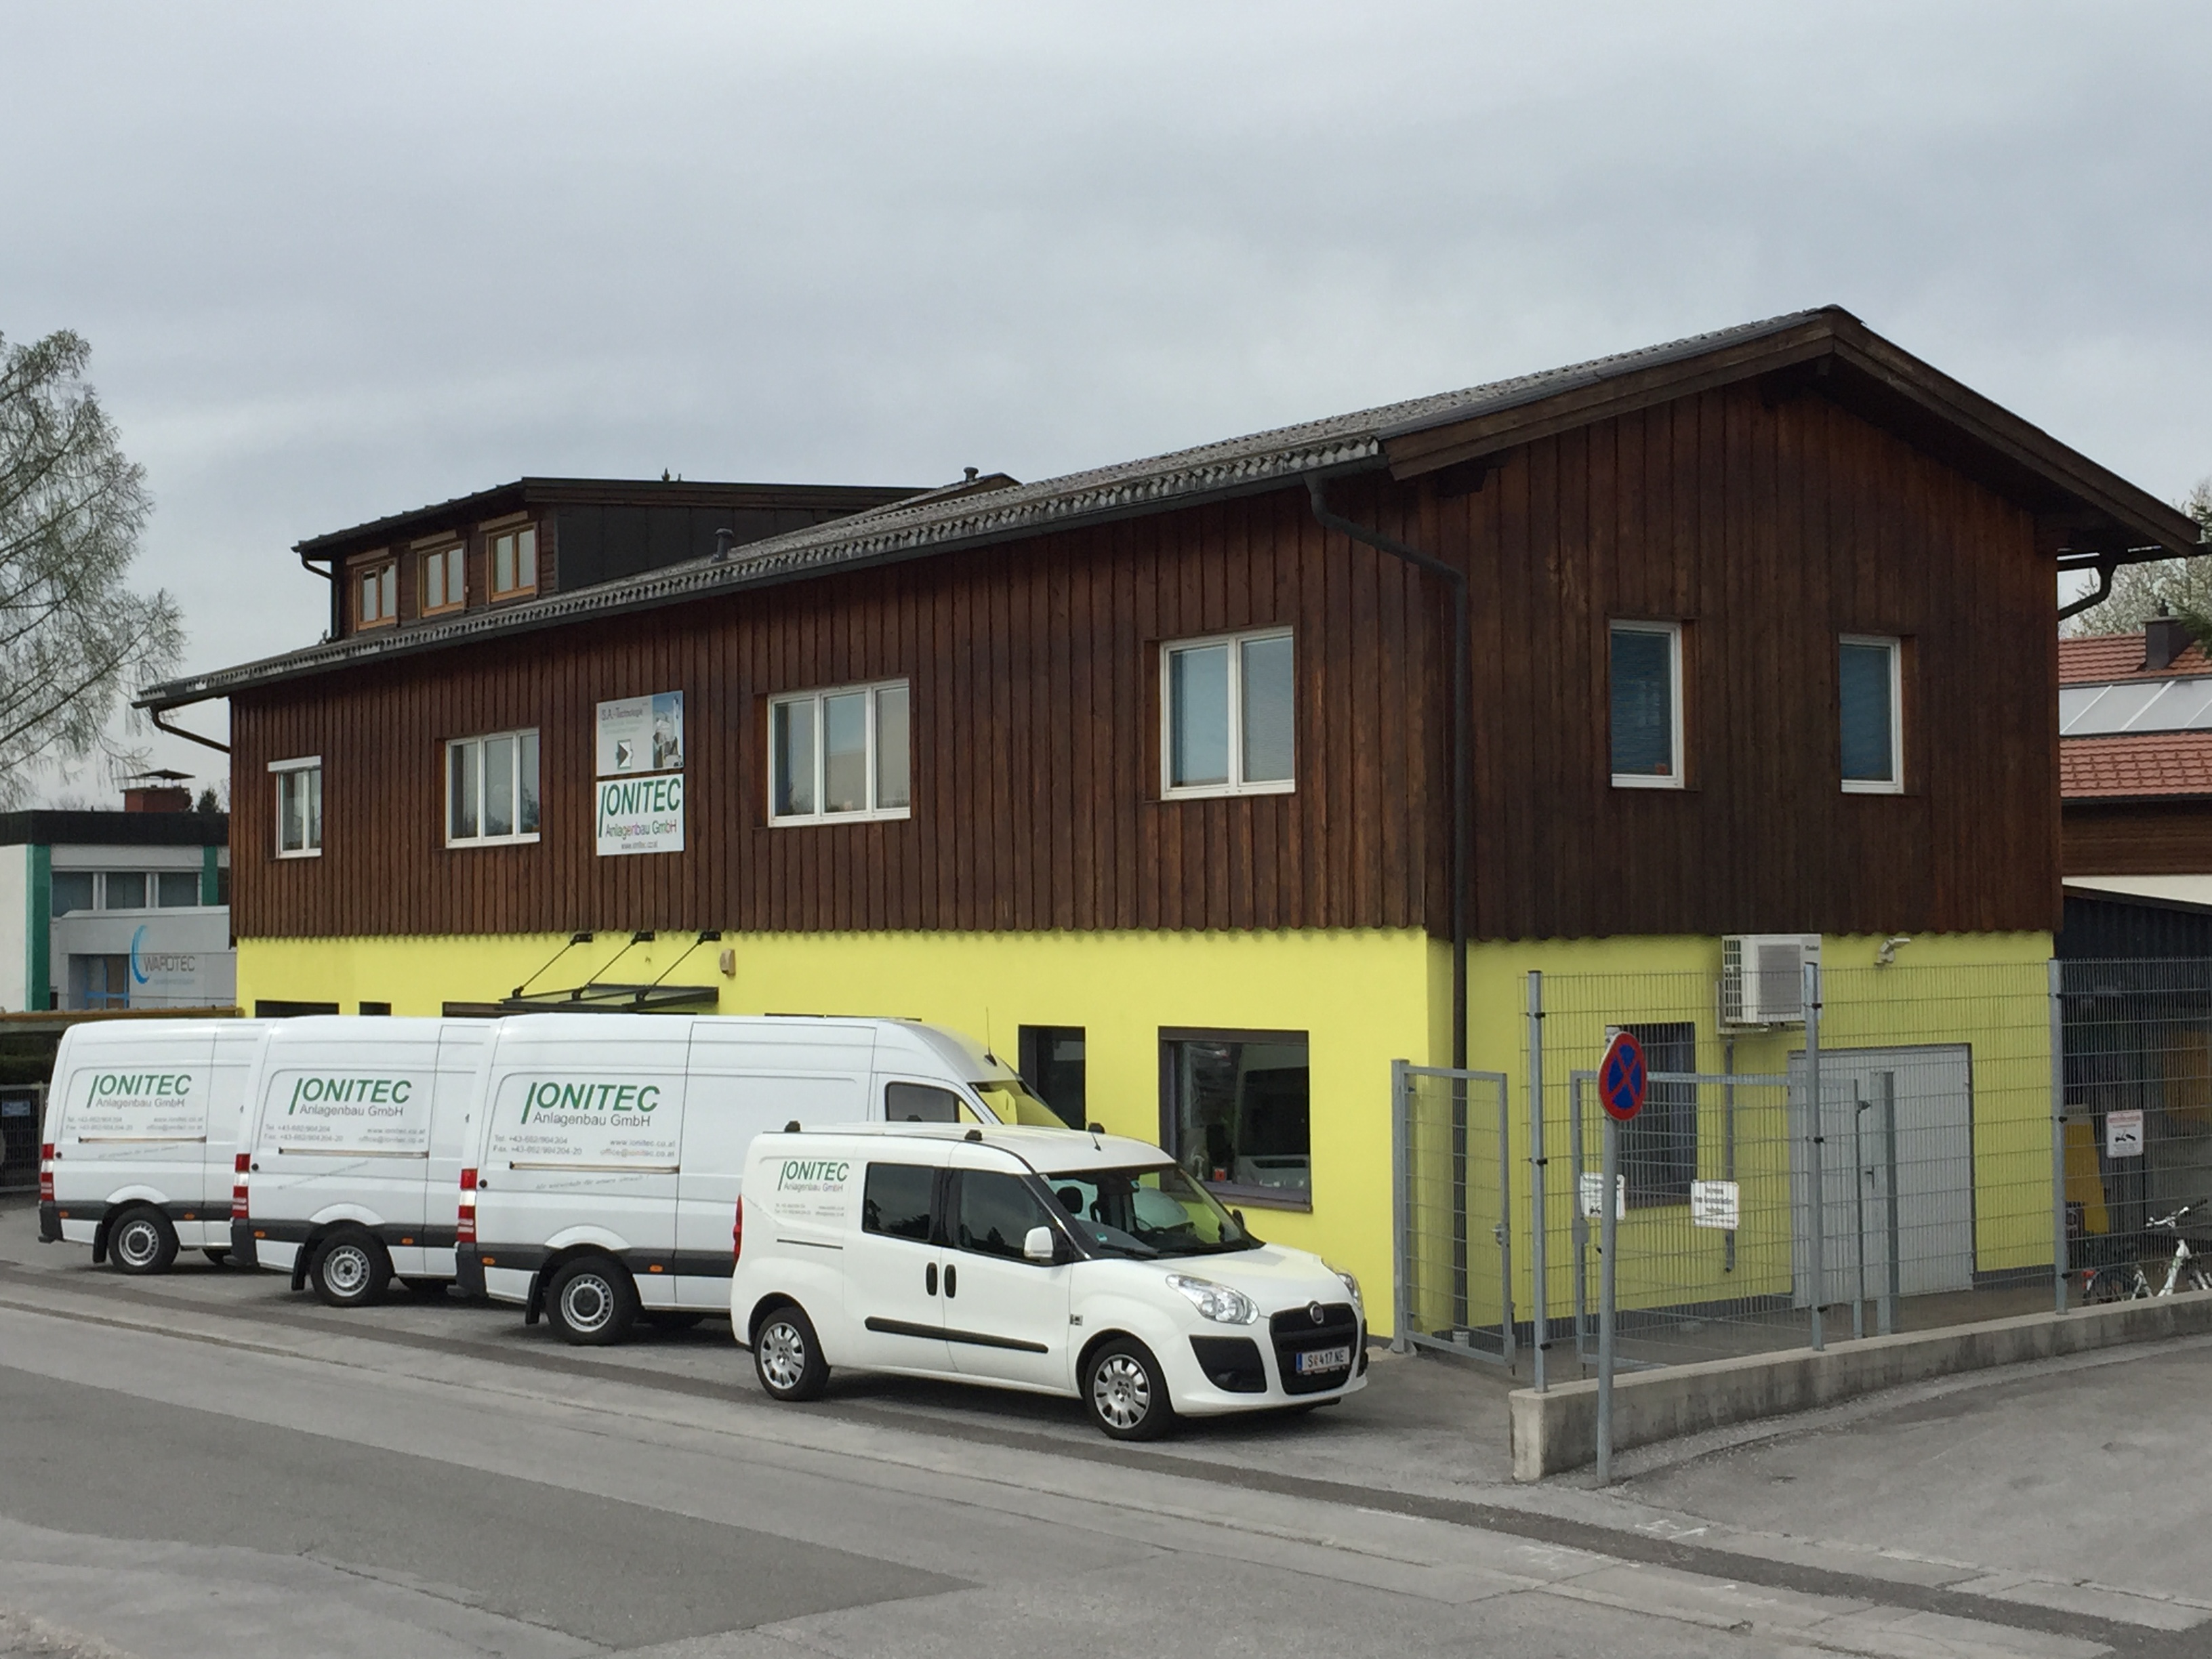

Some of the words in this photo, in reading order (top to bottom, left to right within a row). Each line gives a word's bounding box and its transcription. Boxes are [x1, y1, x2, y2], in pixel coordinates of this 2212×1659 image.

[605, 821, 650, 840] Anlagenbau
[652, 819, 677, 836] GmbH
[144, 956, 195, 972] WAPOTEC
[96, 1098, 152, 1109] Anlagenbau
[155, 1099, 185, 1107] GmbH
[300, 1104, 365, 1118] Anlagenbau
[368, 1105, 404, 1117] GmbH
[533, 1111, 607, 1127] Anlagenbau
[611, 1113, 651, 1127] GmbH
[784, 1182, 821, 1193] Anlagenbau
[823, 1183, 843, 1191] GmbH
[1308, 1354, 1313, 1368] S
